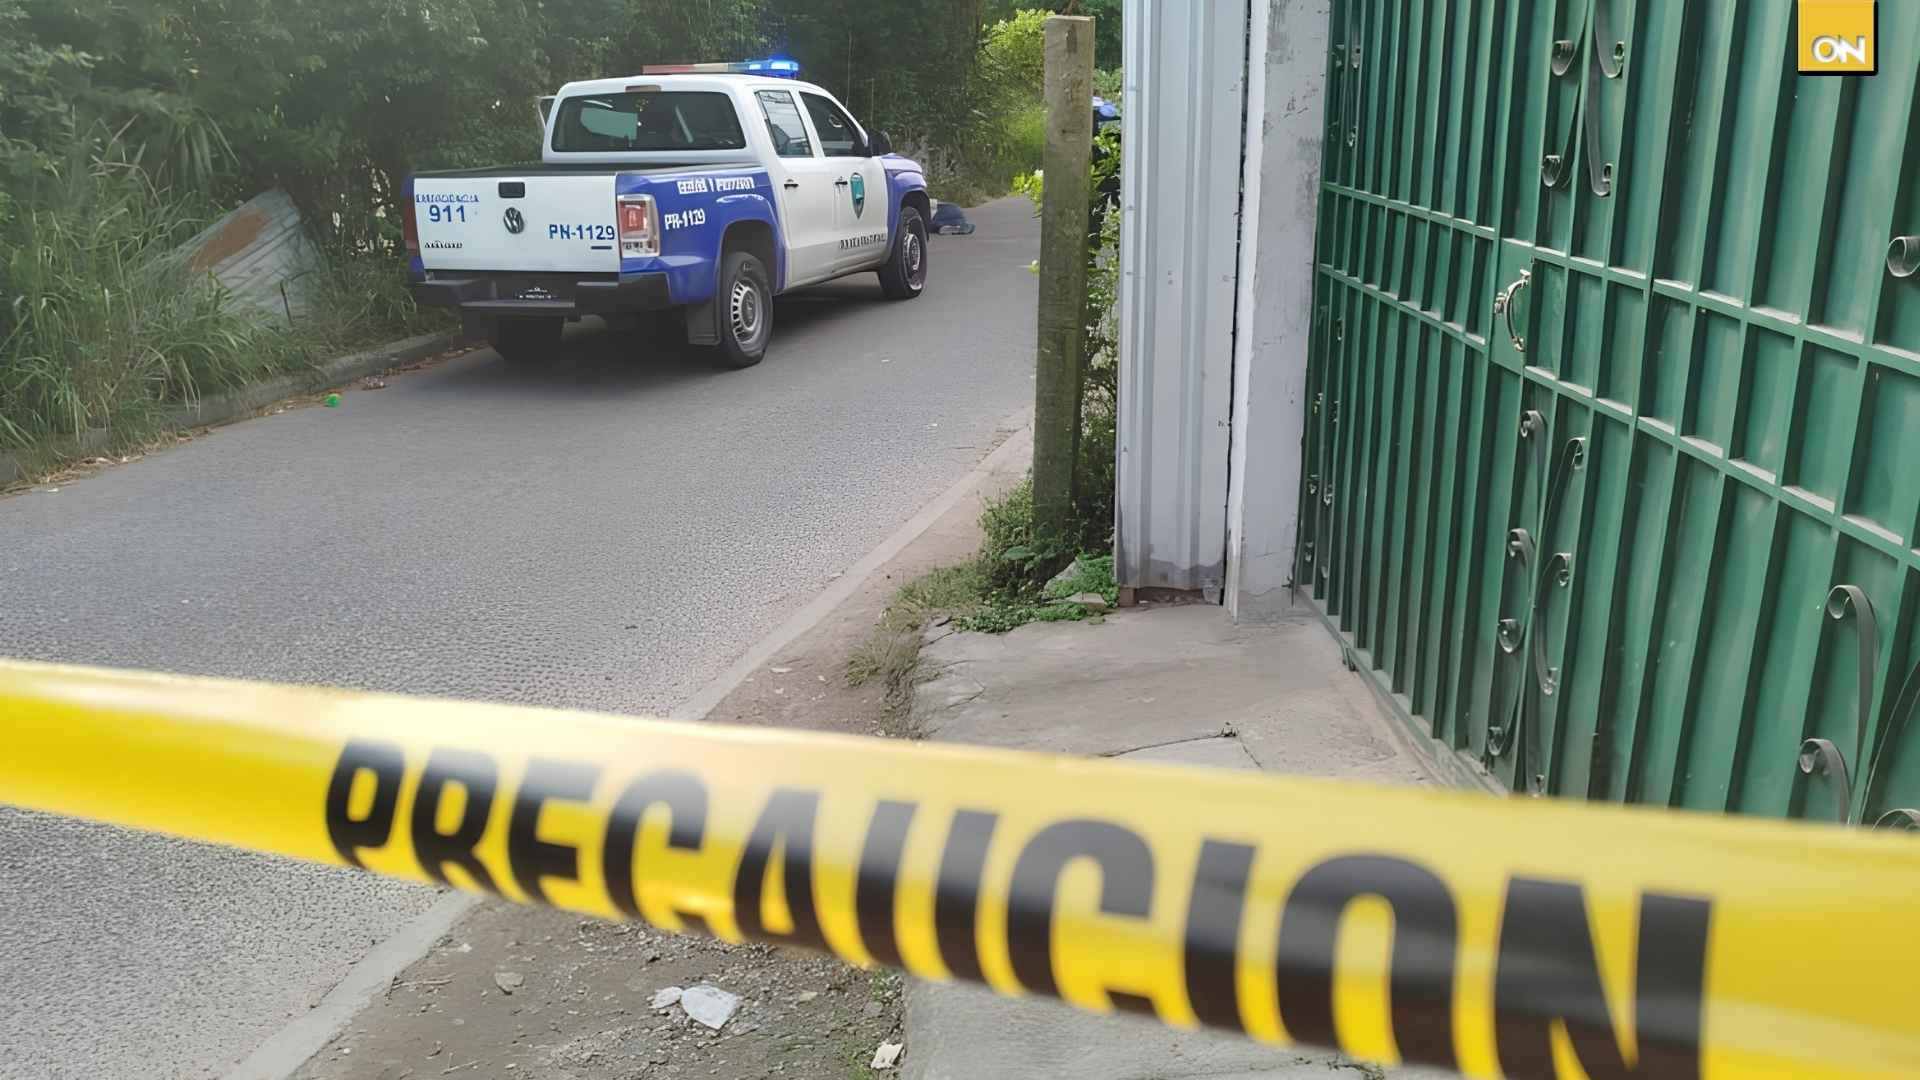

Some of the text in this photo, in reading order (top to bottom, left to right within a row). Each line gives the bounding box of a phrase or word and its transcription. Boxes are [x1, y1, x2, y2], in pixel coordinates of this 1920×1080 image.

[429, 204, 465, 222] 911
[549, 223, 616, 241] PN-1129
[325, 738, 1714, 1080] PRECAUCION
